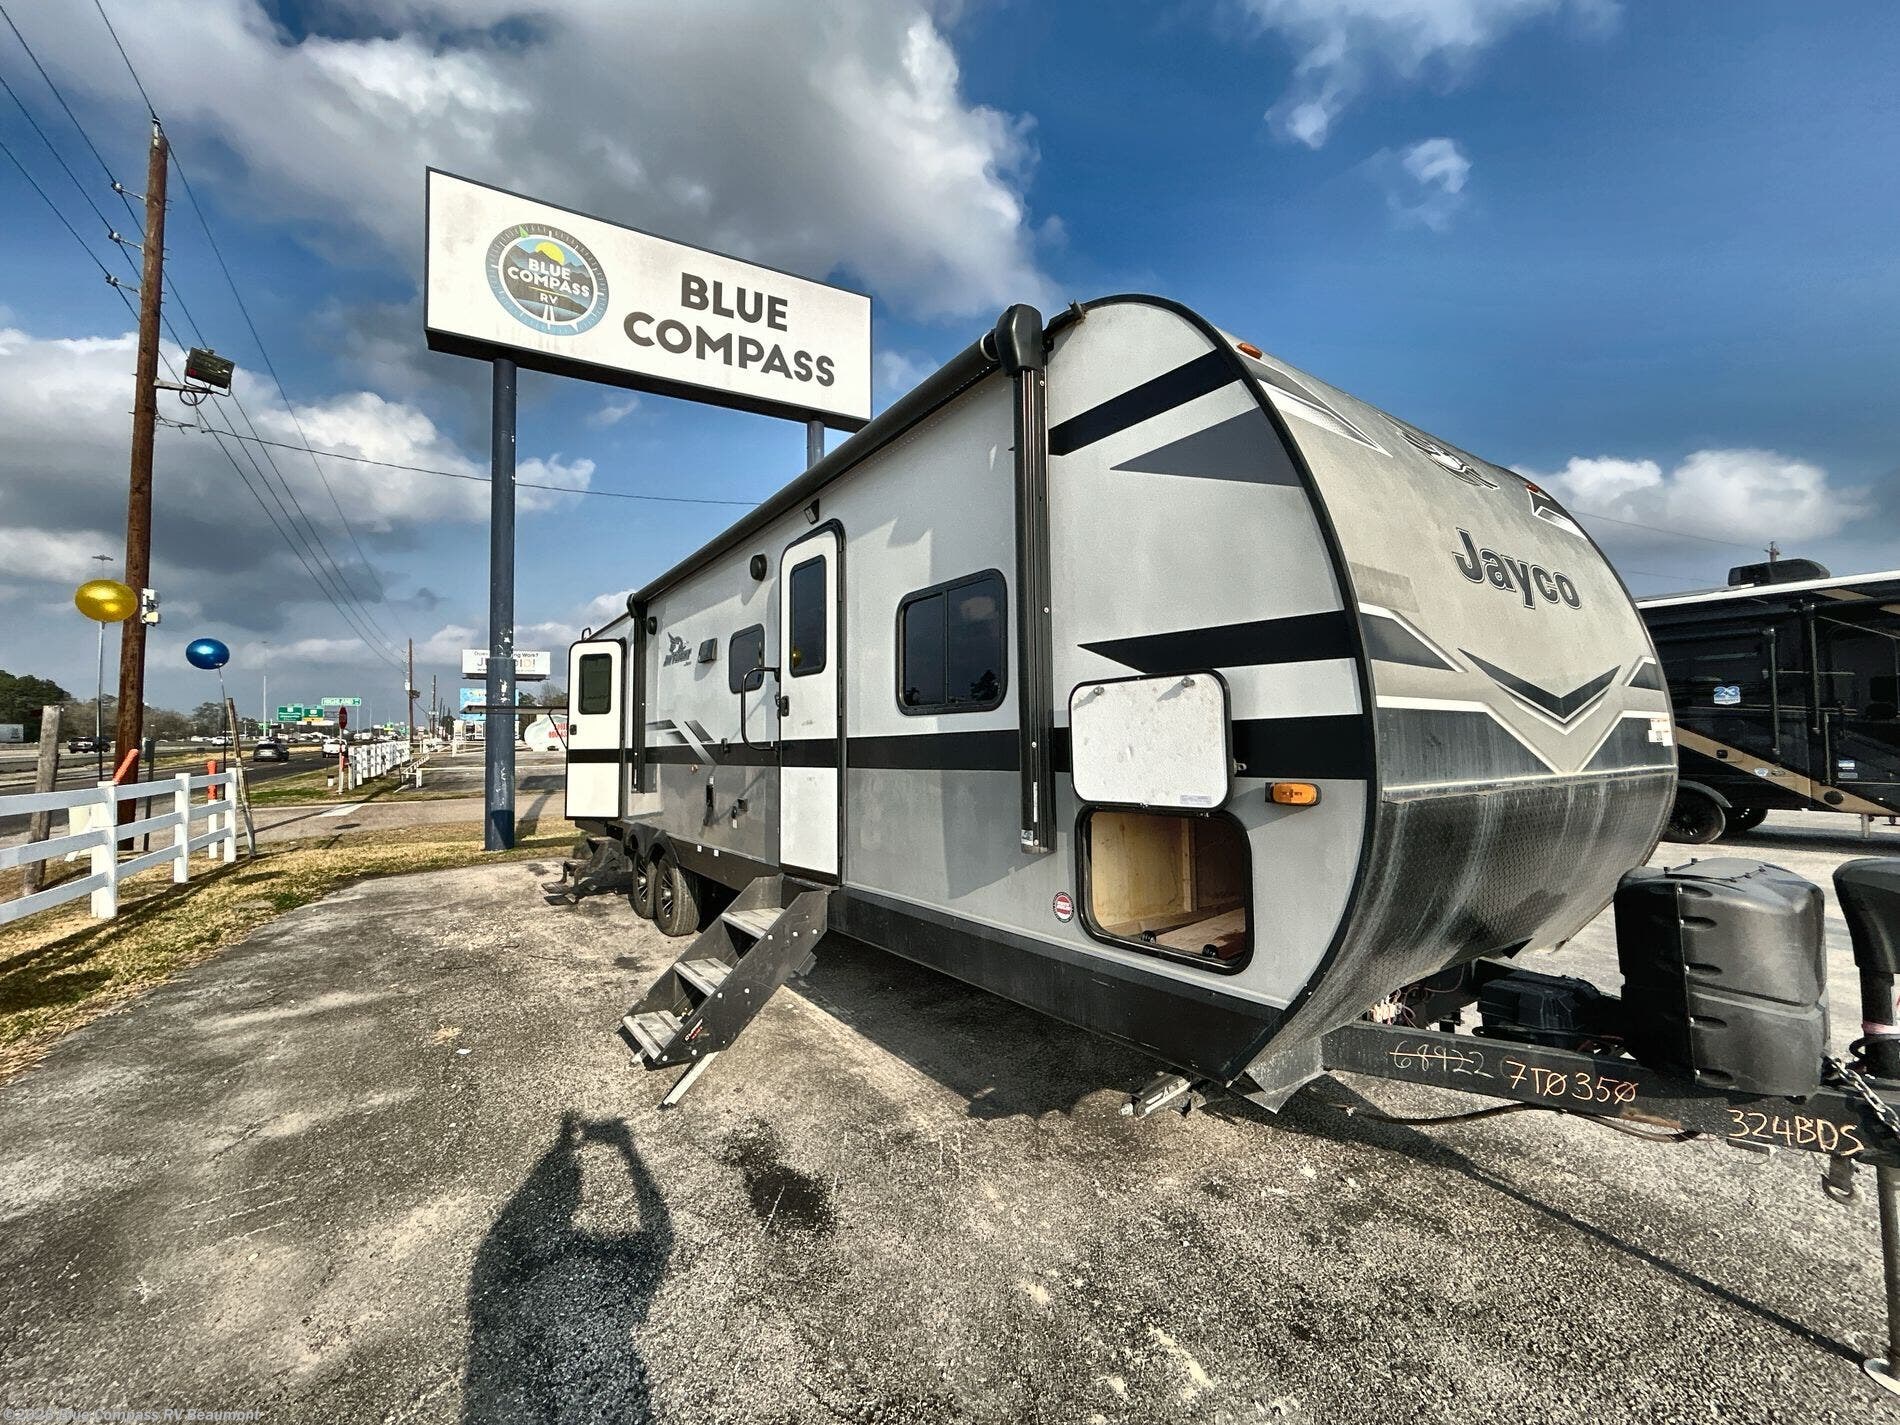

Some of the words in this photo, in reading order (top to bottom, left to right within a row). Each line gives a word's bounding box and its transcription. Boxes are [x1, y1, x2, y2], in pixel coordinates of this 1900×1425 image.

[507, 266, 590, 298] COMPASS
[528, 258, 571, 281] BLUE
[539, 293, 559, 304] RV
[681, 271, 788, 332] BLUE
[623, 311, 835, 387] COMPASS
[1451, 526, 1582, 610] Jayco
[1726, 1108, 1865, 1157] 324BDS
